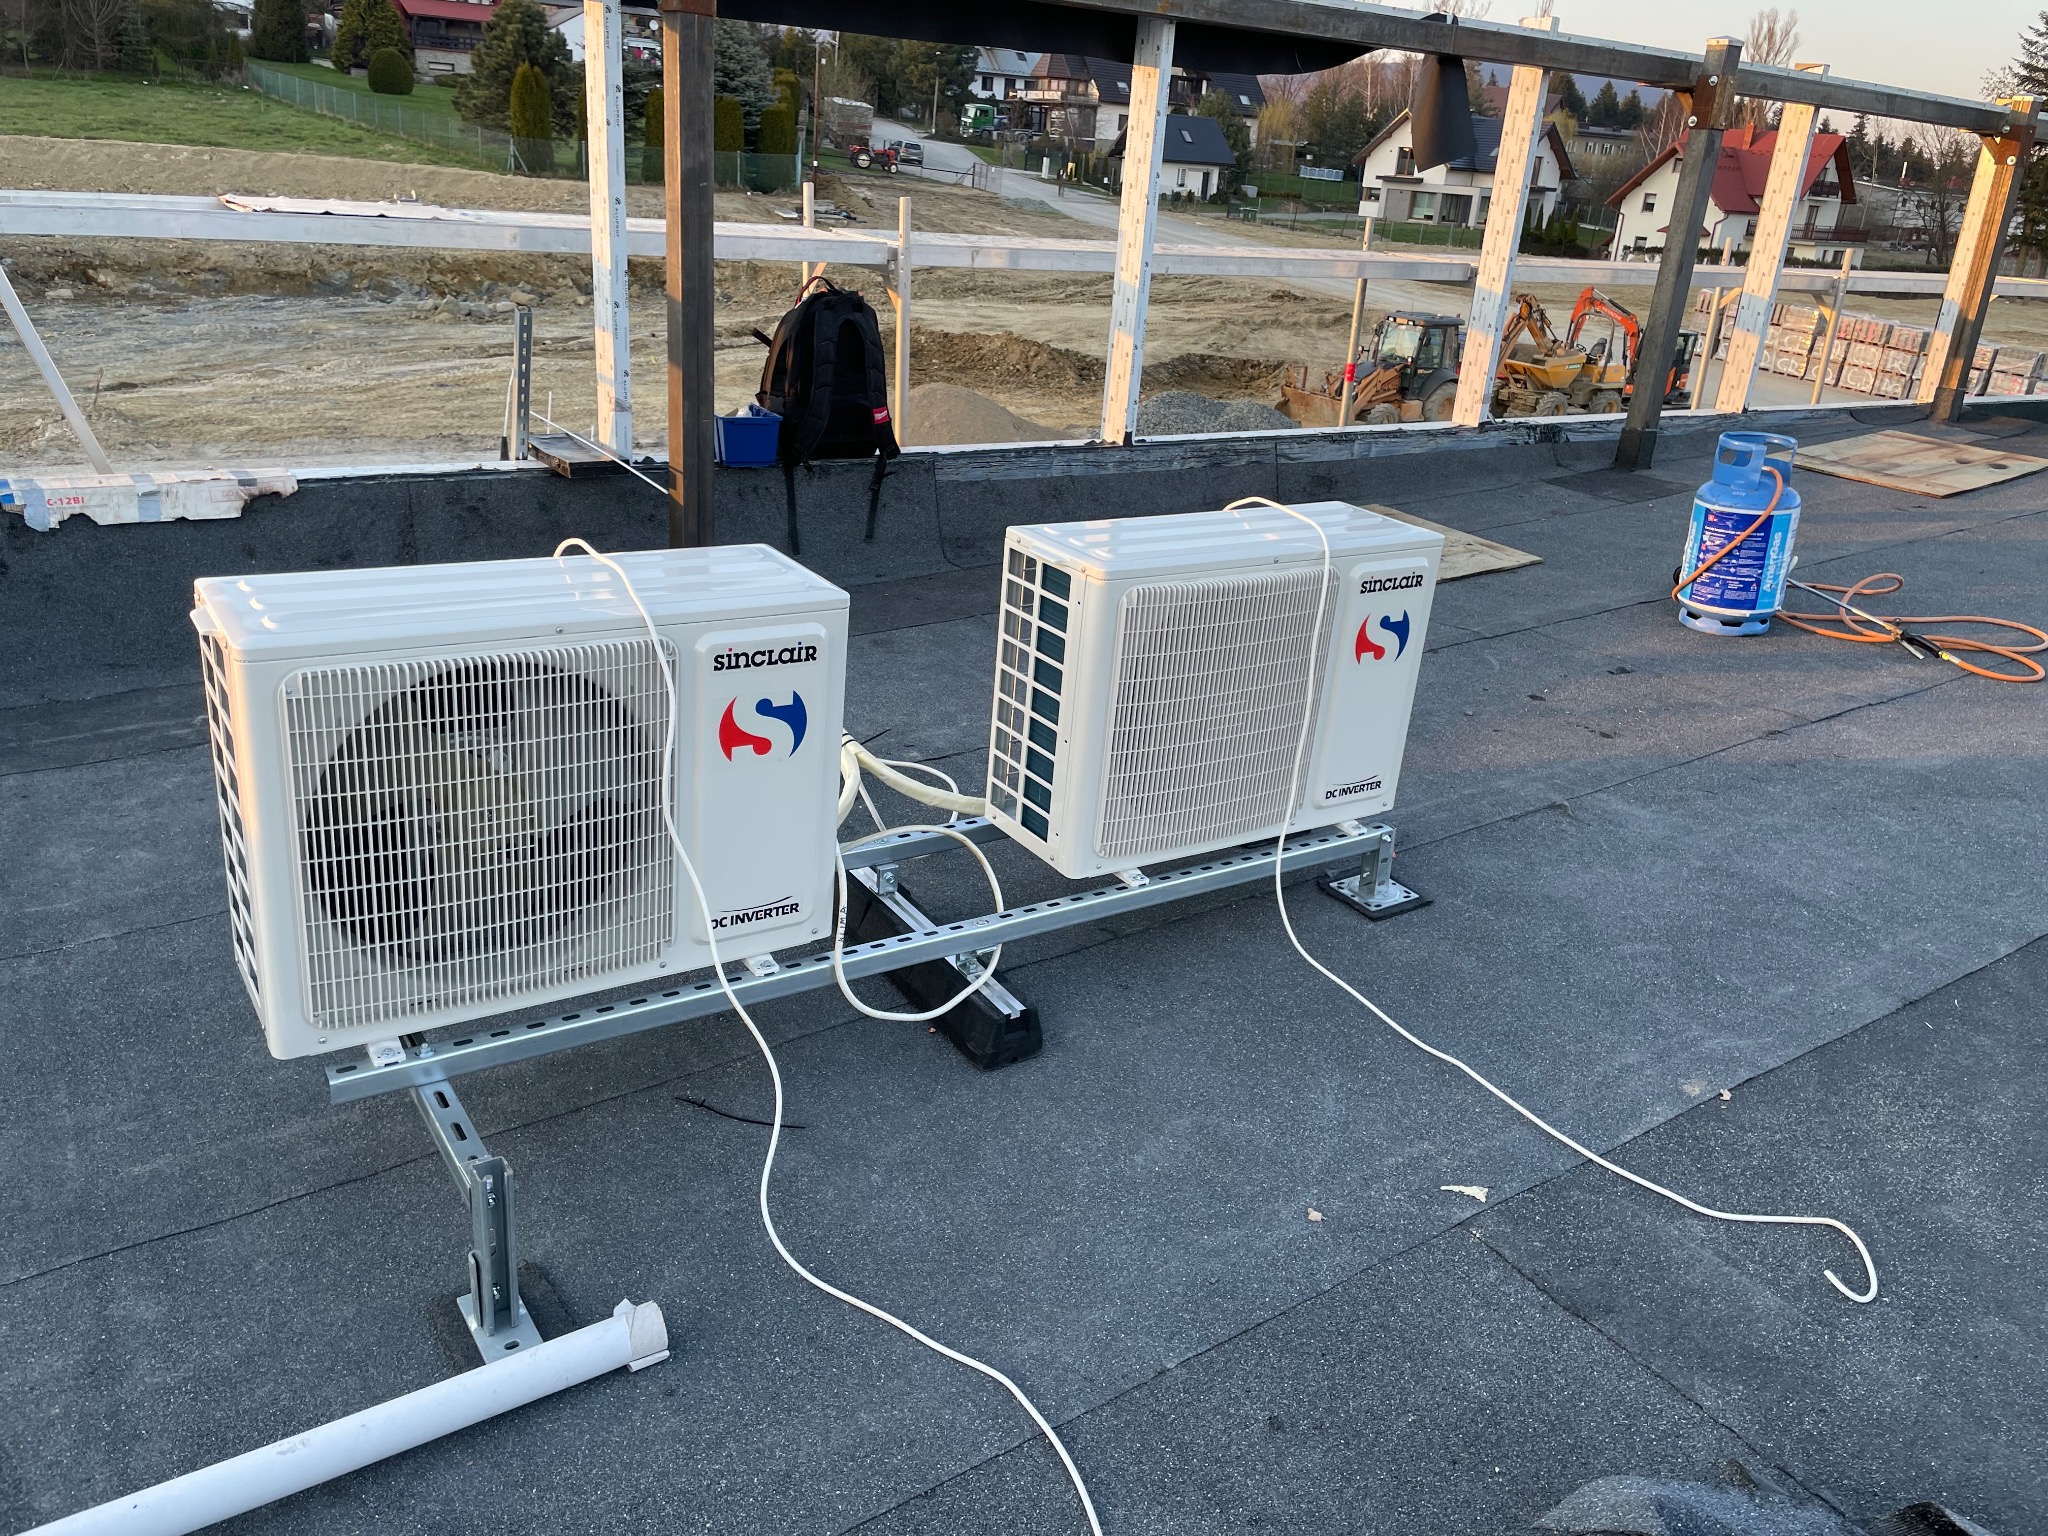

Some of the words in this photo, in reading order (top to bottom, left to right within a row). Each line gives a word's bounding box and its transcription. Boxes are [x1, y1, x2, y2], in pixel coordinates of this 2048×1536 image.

[1325, 789, 1338, 800] DC
[1338, 780, 1382, 797] INVERTER
[730, 902, 800, 926] INVERTER
